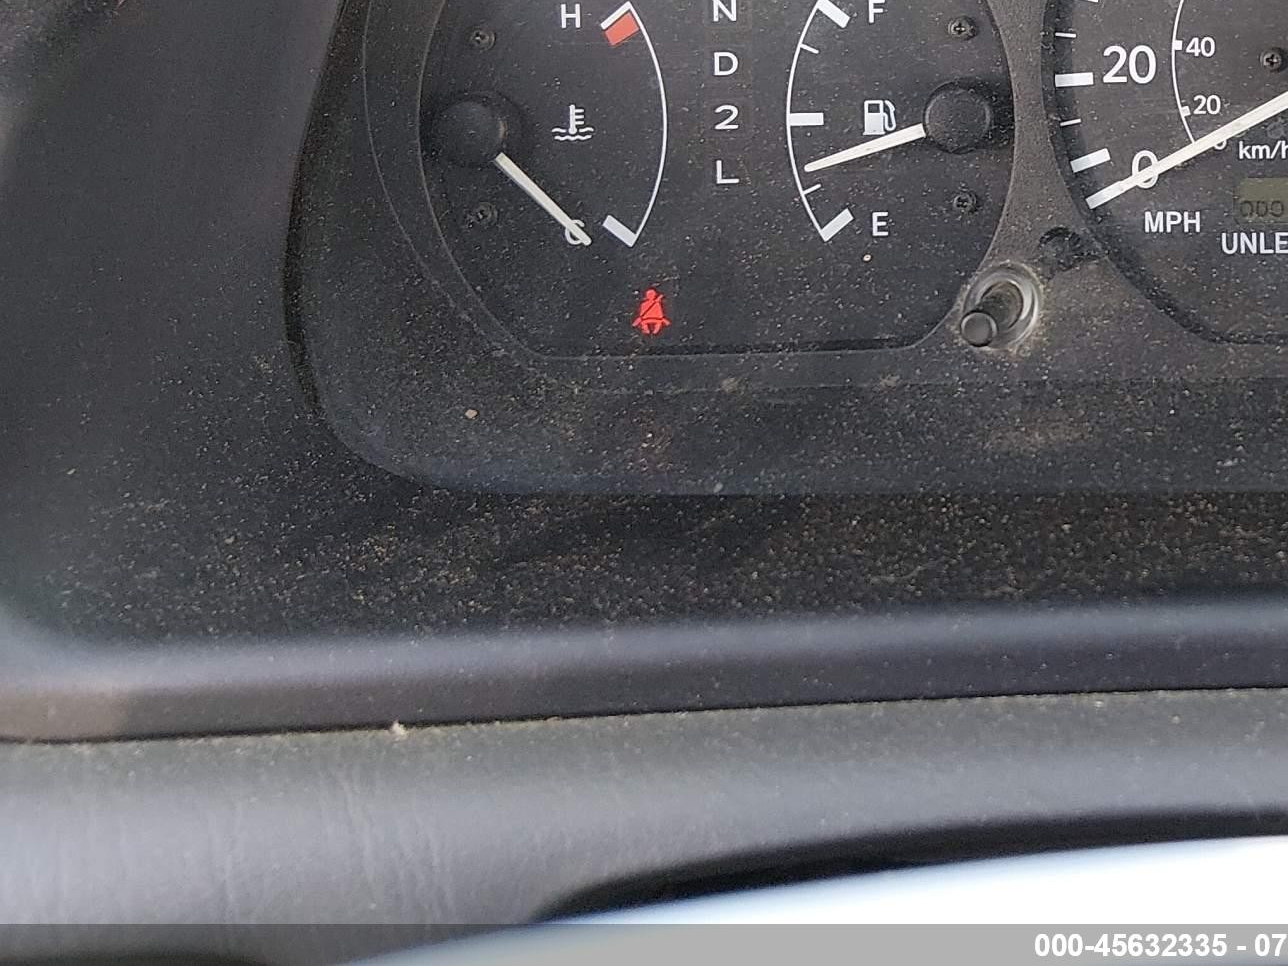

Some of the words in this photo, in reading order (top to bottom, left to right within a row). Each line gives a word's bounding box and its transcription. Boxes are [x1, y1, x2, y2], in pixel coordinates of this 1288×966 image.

[560, 4, 581, 29] H
[868, 0, 886, 24] F
[1186, 37, 1215, 57] 40
[714, 52, 738, 75] D
[1102, 45, 1157, 83] 20
[1193, 94, 1221, 115] 20
[715, 105, 739, 129] 2
[717, 161, 740, 184] L
[1132, 150, 1158, 188] 0
[872, 212, 889, 237] E
[1145, 212, 1201, 233] MPH
